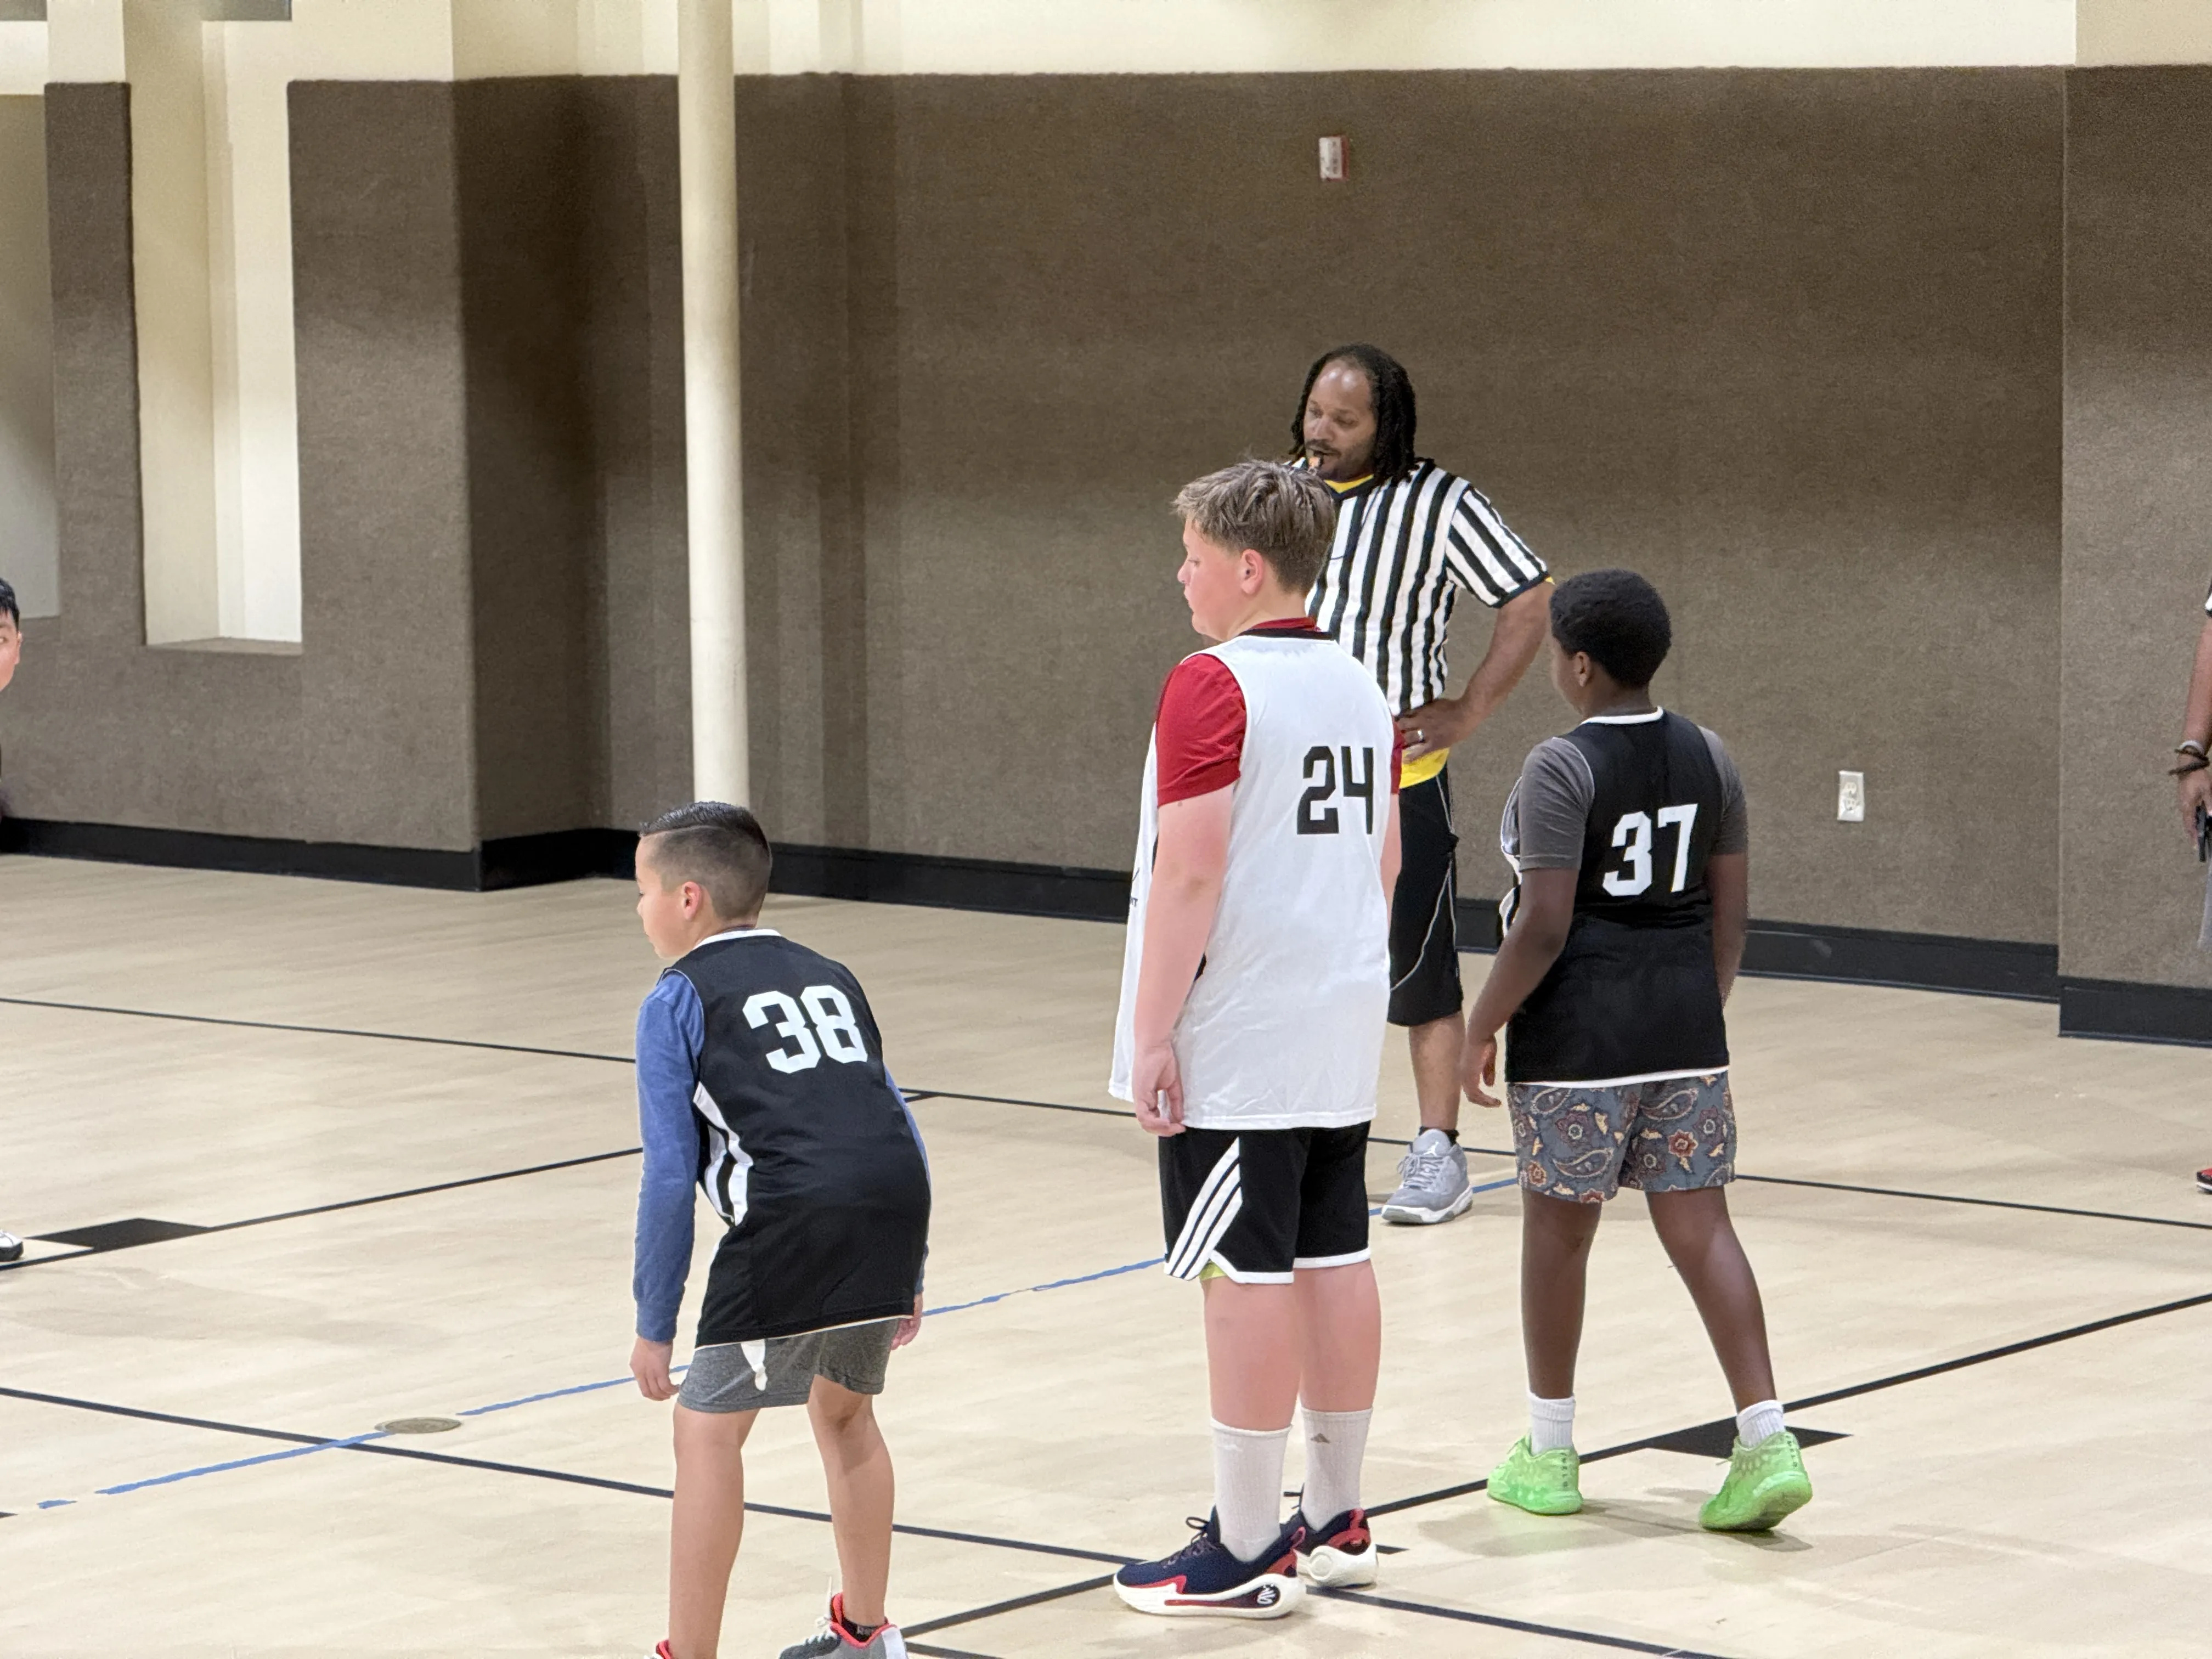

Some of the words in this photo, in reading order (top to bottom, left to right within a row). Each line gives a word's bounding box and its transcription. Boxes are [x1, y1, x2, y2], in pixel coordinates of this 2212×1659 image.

[1296, 746, 1374, 835] 24
[1602, 803, 1699, 896] 37
[742, 985, 868, 1074] 38
